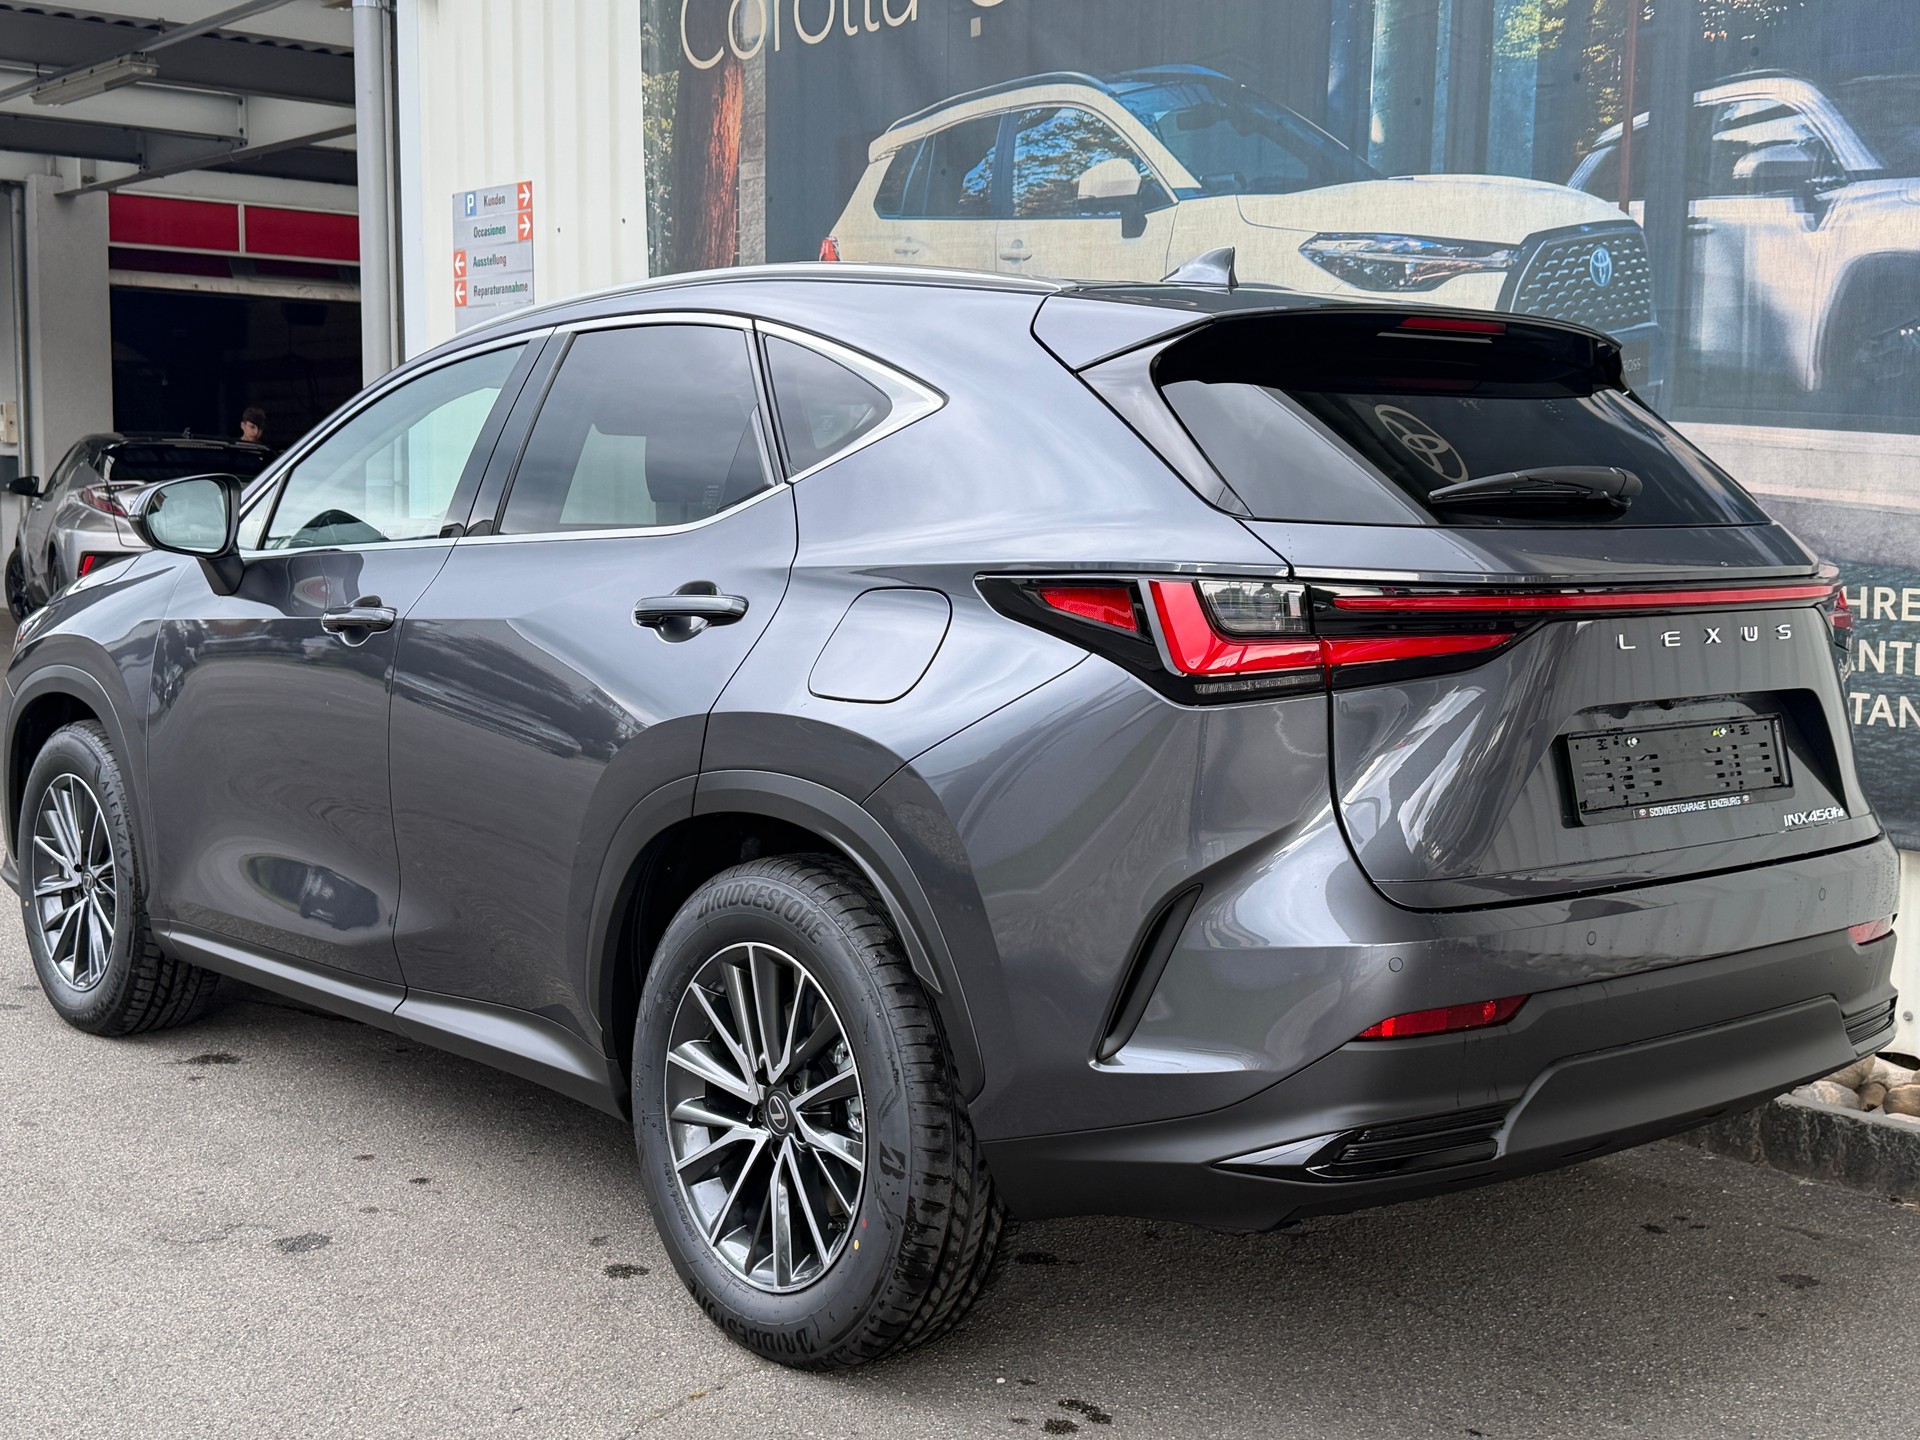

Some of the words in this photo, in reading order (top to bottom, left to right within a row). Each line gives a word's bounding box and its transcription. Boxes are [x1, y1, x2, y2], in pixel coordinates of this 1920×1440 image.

[483, 193, 506, 207] Kunden
[473, 224, 506, 238] Occasionen
[473, 253, 507, 268] Ausstellung
[473, 281, 528, 299] Reparaturannahme
[1616, 624, 1792, 650] LEXUS
[1707, 796, 1741, 809] LENZBURG
[697, 883, 829, 944] BRIDGESTONE
